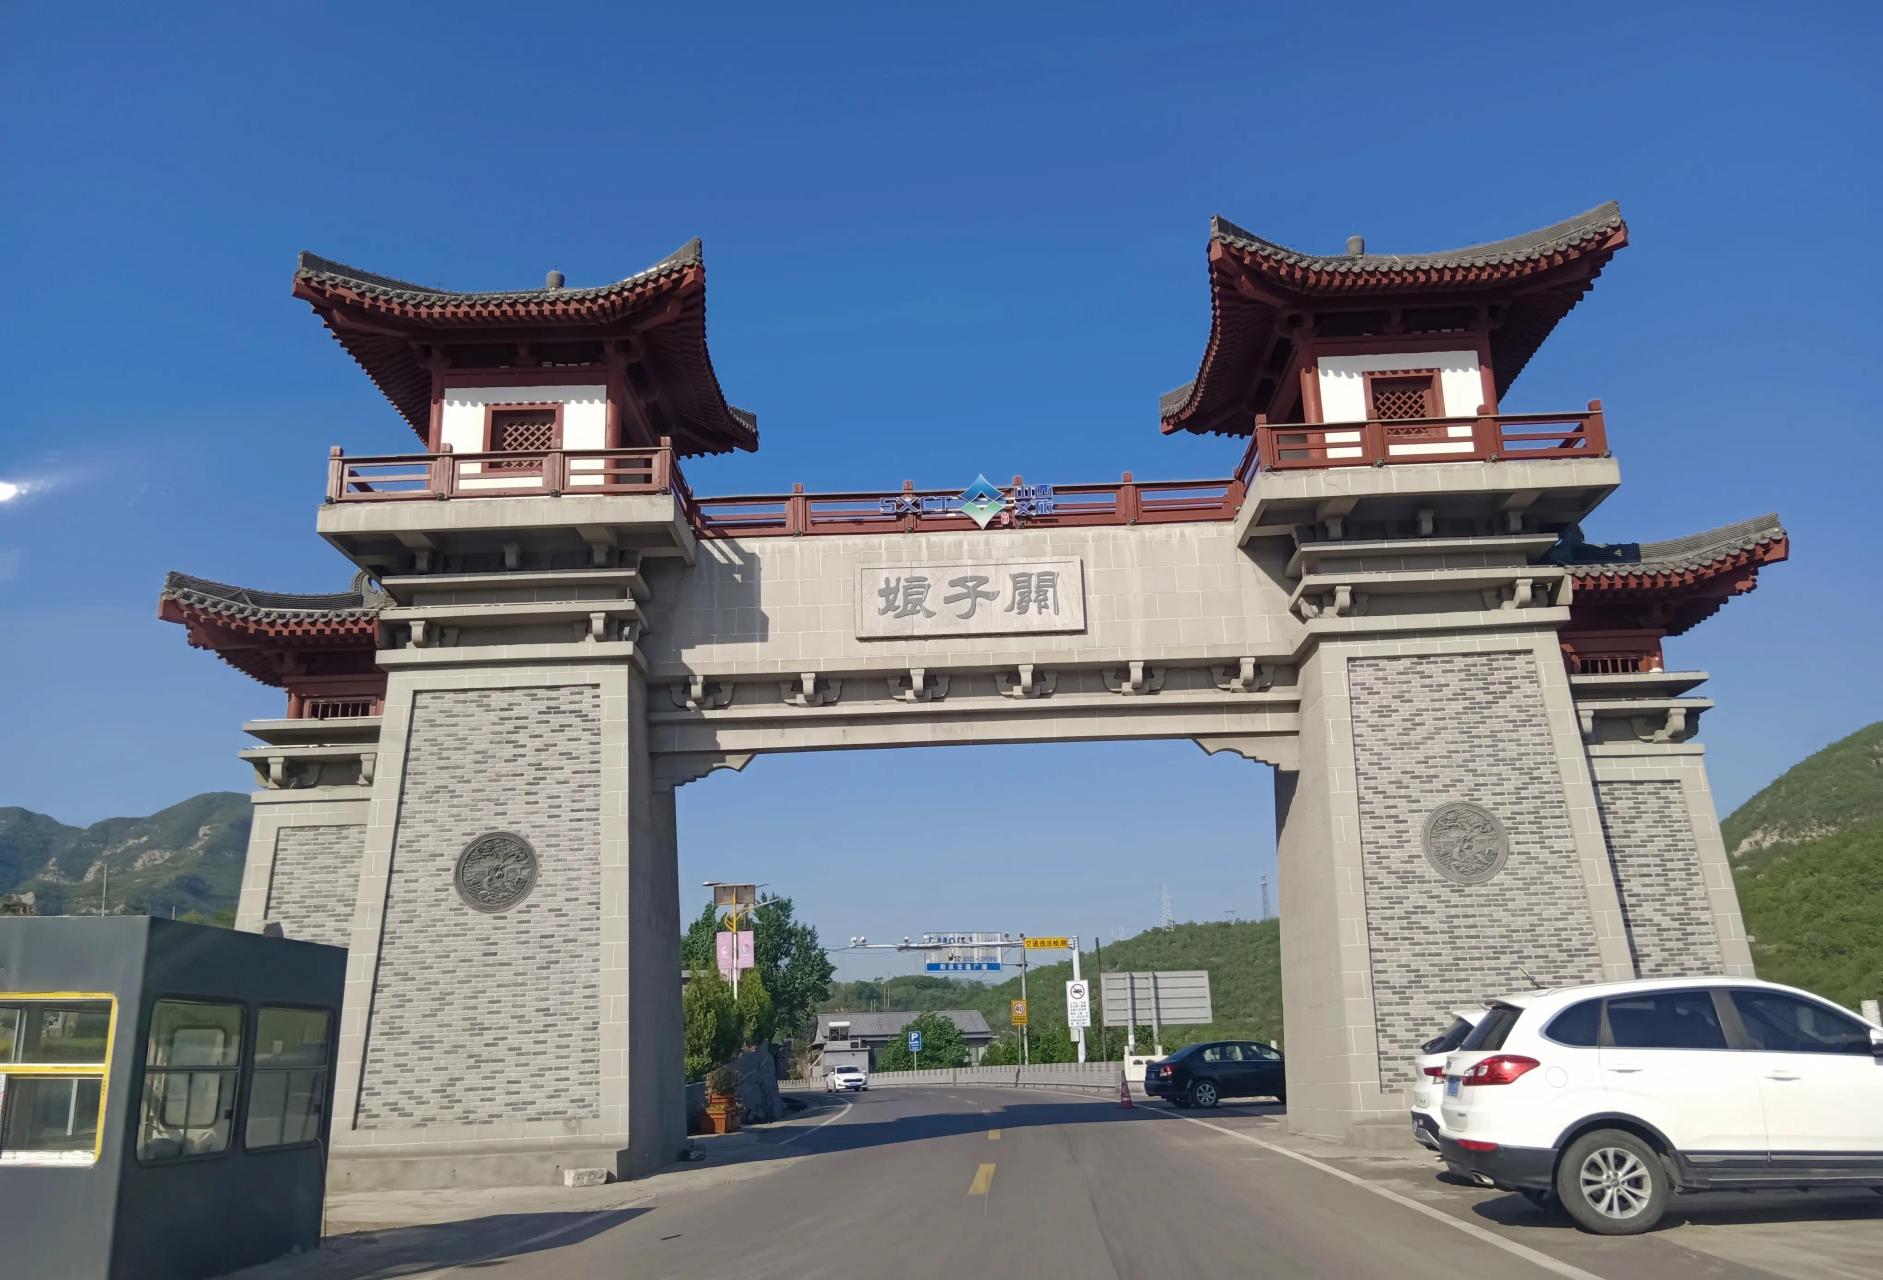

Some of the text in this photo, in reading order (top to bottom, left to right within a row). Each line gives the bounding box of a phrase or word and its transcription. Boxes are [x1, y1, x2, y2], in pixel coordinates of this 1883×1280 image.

[1013, 483, 1053, 499] 山西
[879, 495, 953, 514] SXCT
[911, 1033, 918, 1041] P
